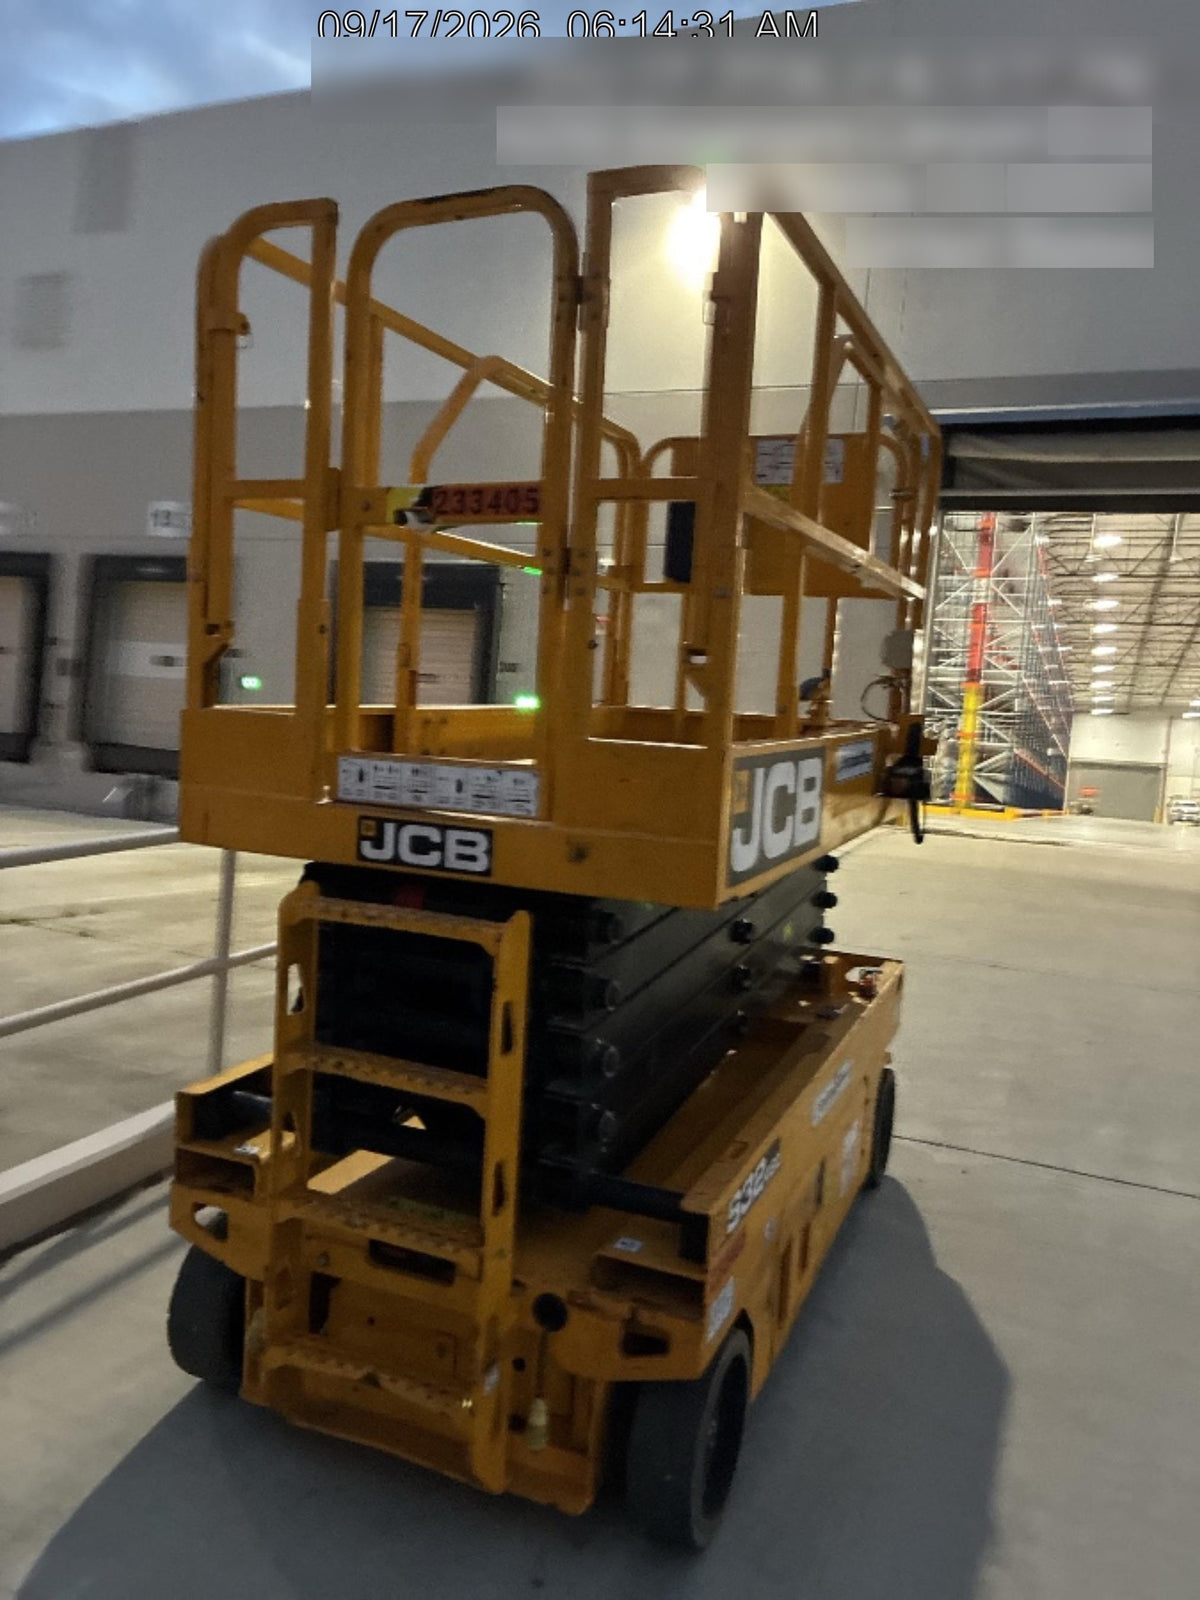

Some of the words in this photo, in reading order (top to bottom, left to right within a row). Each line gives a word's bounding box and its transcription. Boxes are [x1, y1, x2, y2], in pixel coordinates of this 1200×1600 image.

[434, 486, 539, 515] 233405
[730, 757, 823, 872] JCB
[360, 822, 491, 873] JCB
